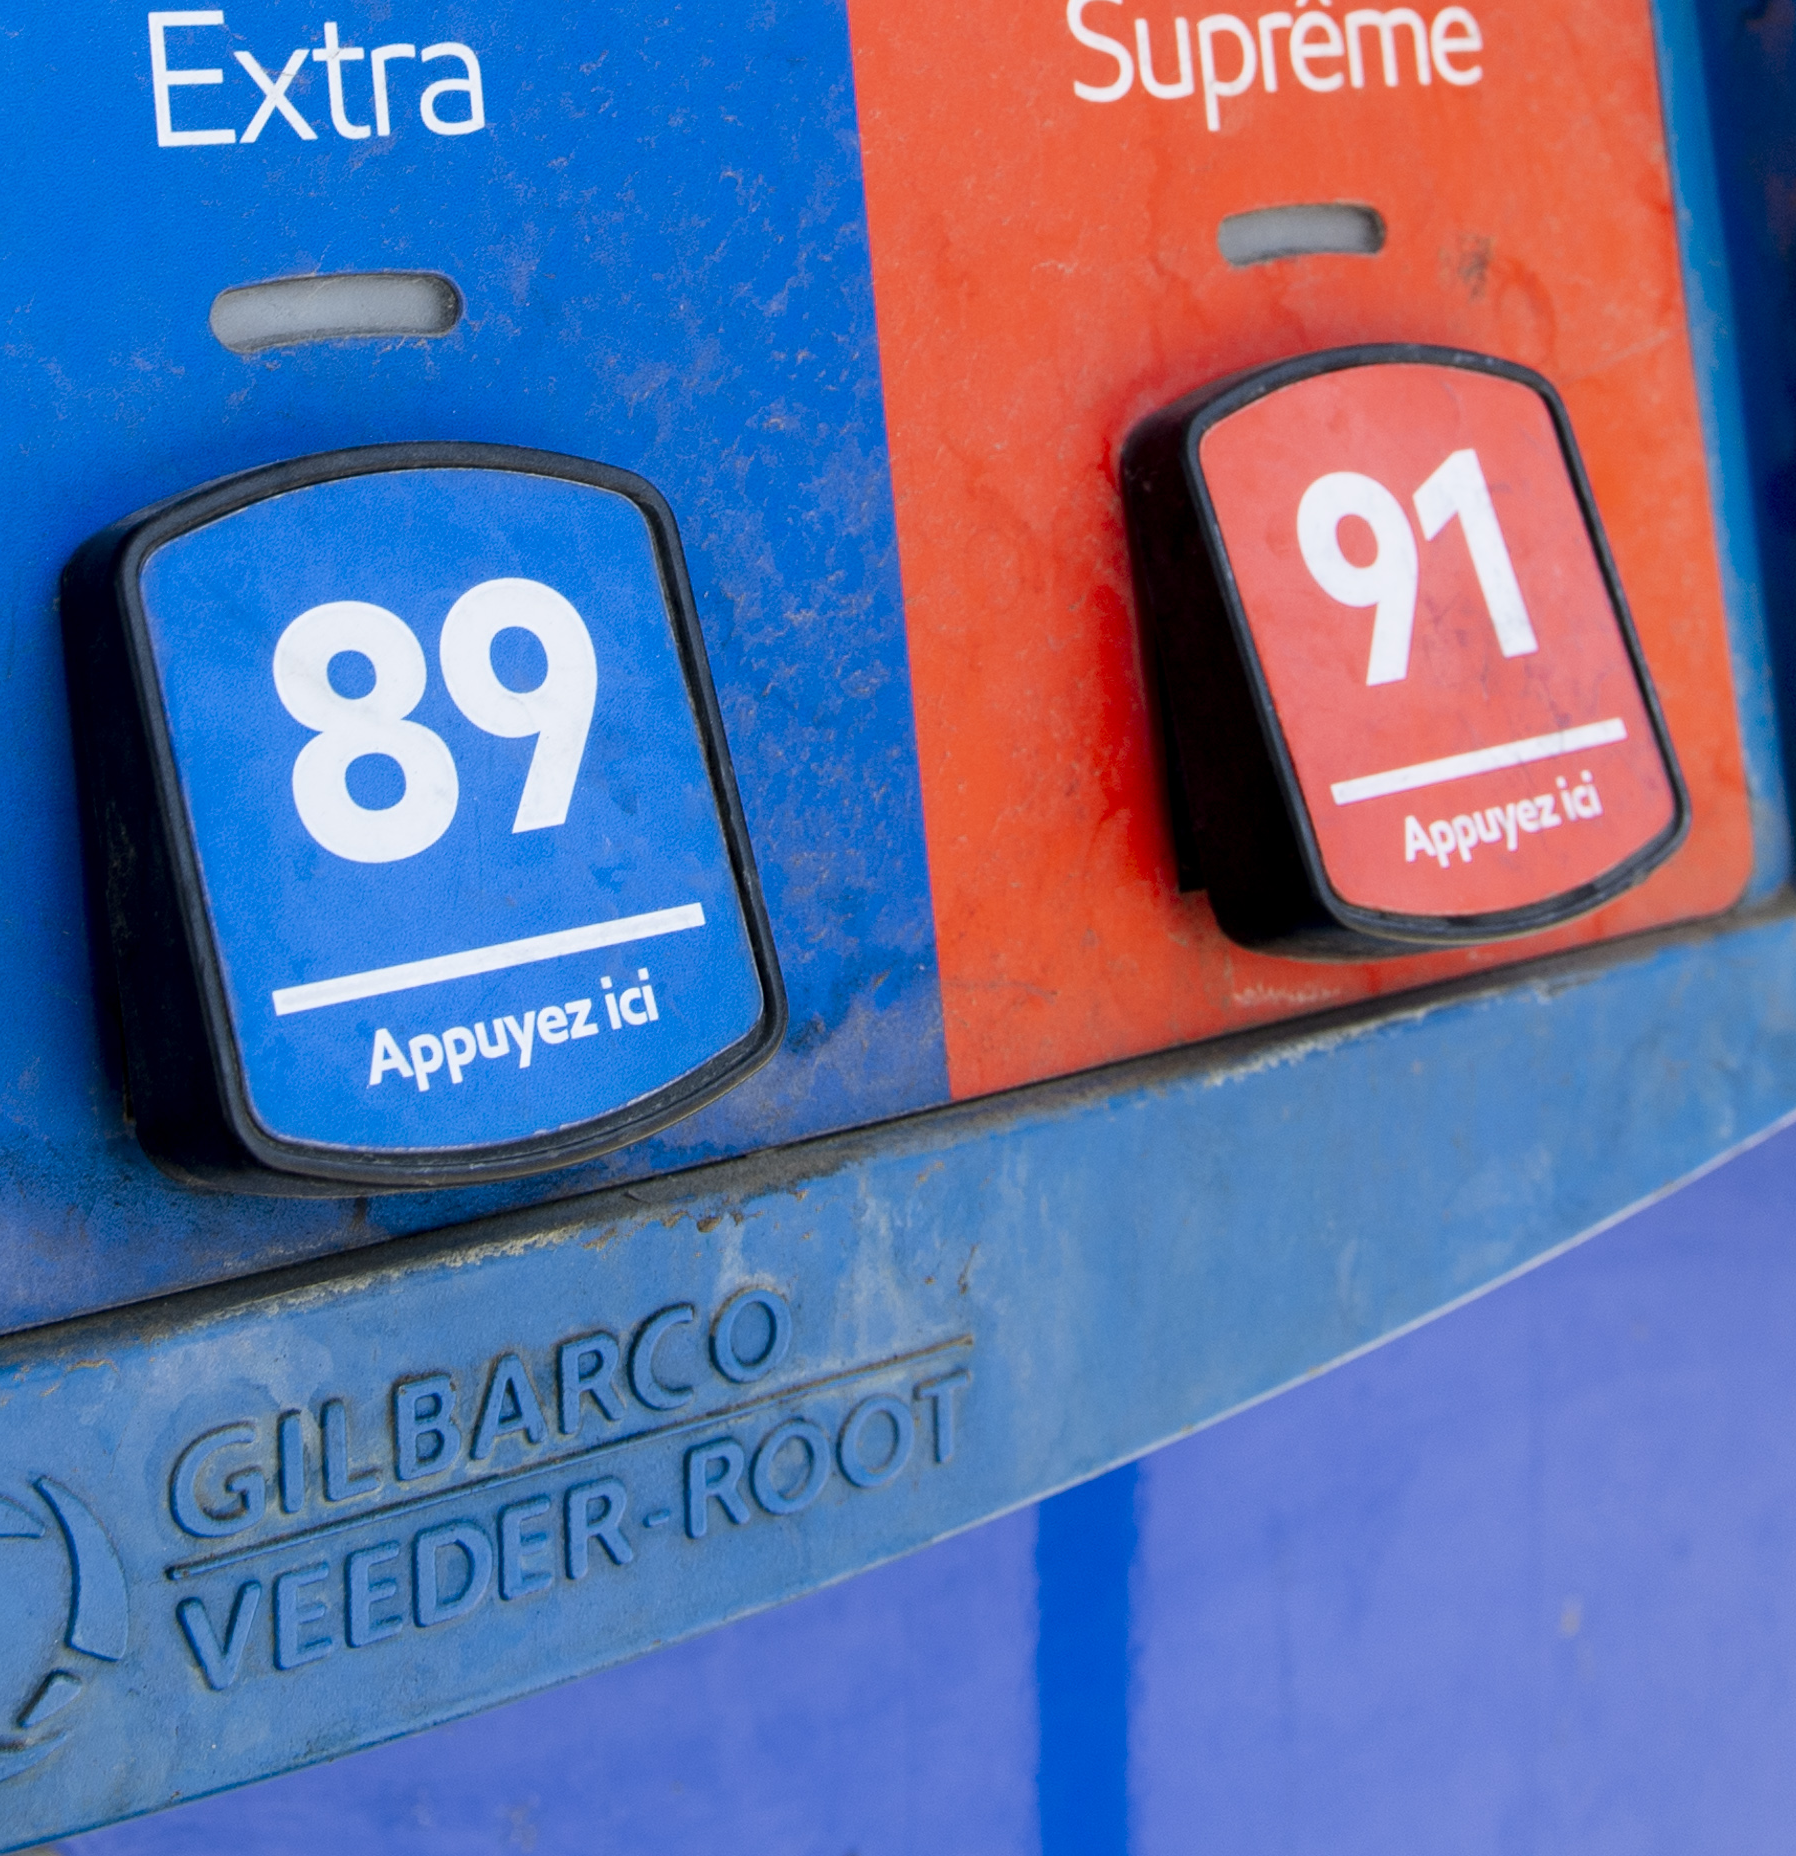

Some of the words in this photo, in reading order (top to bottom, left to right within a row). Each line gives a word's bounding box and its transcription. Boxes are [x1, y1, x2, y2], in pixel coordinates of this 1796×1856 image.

[148, 10, 486, 148] Extra
[1297, 448, 1538, 687] 91
[272, 577, 598, 864] 89
[1405, 794, 1560, 869] Appuyez
[1555, 770, 1603, 821] ici
[368, 997, 598, 1092] Appuyez
[601, 968, 659, 1028] ici
[168, 1286, 795, 1540] GILBARCO
[175, 1369, 972, 1691] VEEDER-ROOT
